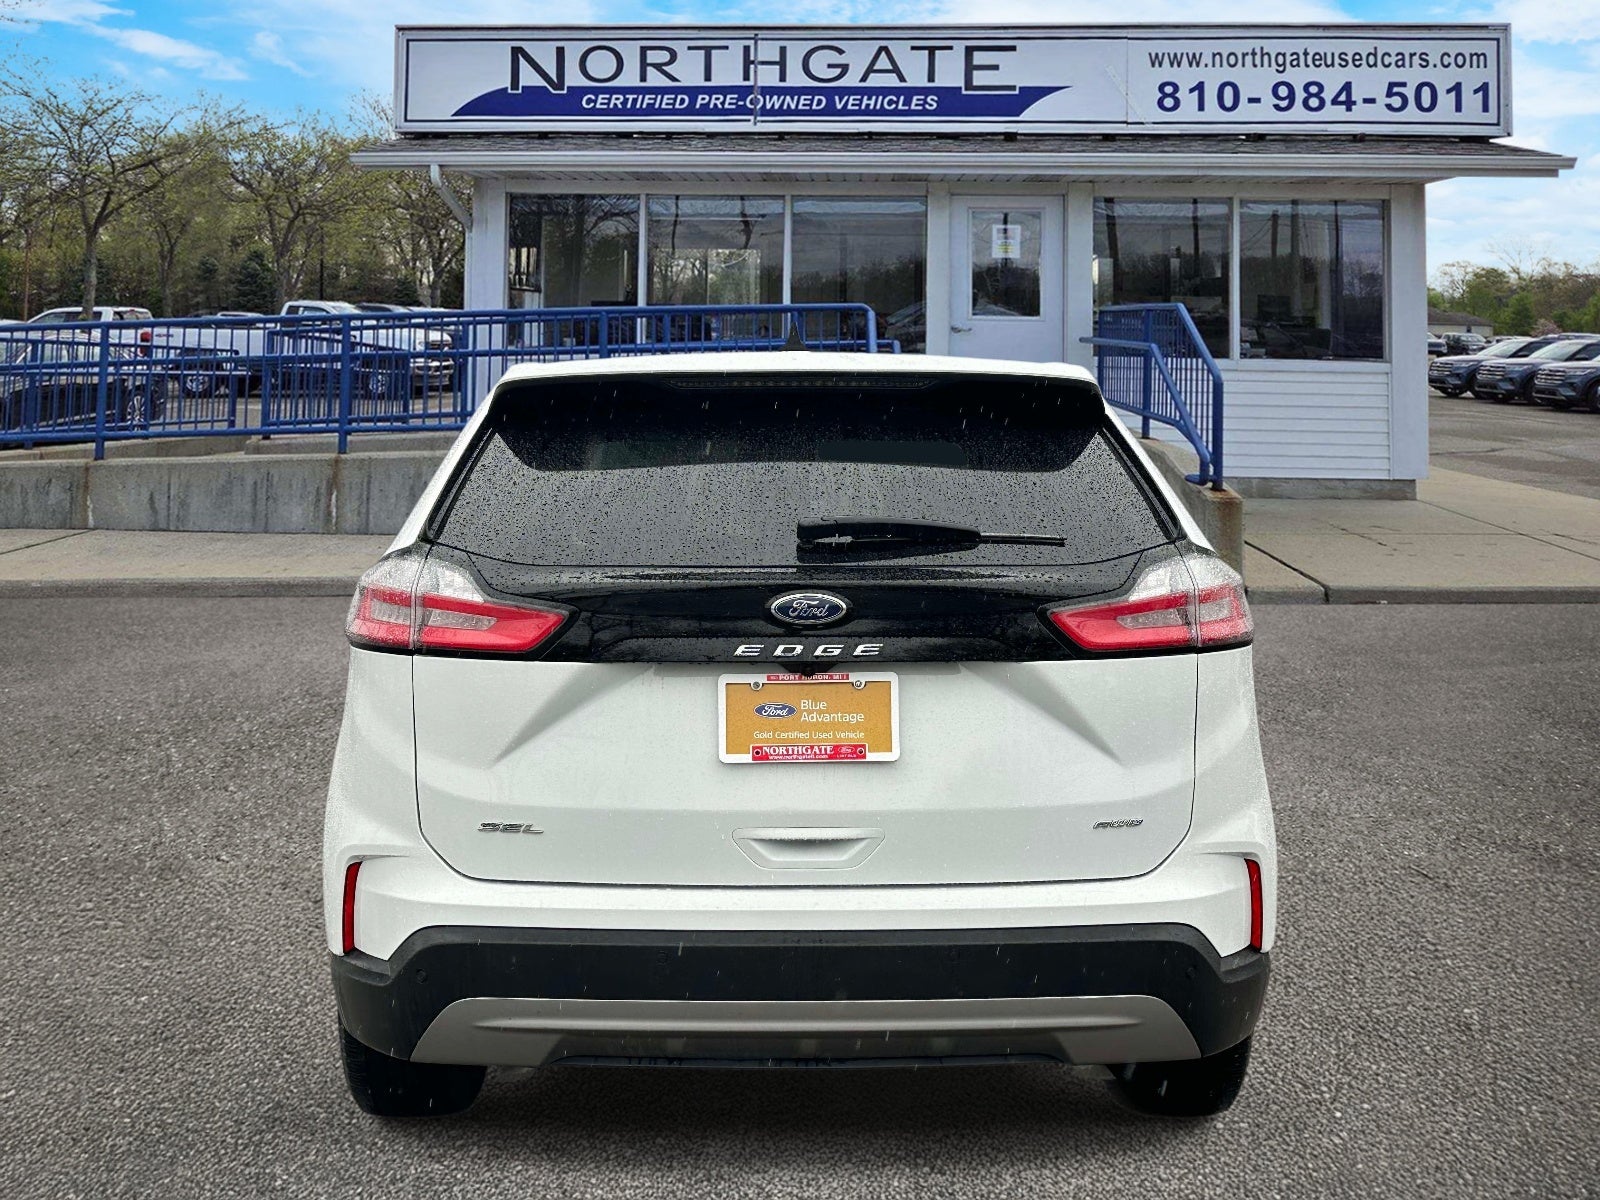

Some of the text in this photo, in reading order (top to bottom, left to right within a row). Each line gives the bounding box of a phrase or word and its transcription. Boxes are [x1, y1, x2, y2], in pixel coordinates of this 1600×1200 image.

[1148, 46, 1489, 73] www.northgateusedcars.com
[509, 44, 1018, 92] NORTHGATE
[581, 94, 939, 111] CERTIFIED PRE-OWNED VEHICLES
[1157, 80, 1490, 113] 810-984-5011
[788, 600, 830, 617] Ford
[733, 643, 884, 657] EDGE
[762, 700, 828, 716] Ford Blue
[800, 712, 865, 723] Advantage
[753, 731, 865, 739] Gold Certified Used Vehicle
[762, 745, 835, 755] NORTHGATE
[478, 822, 545, 834] SEL
